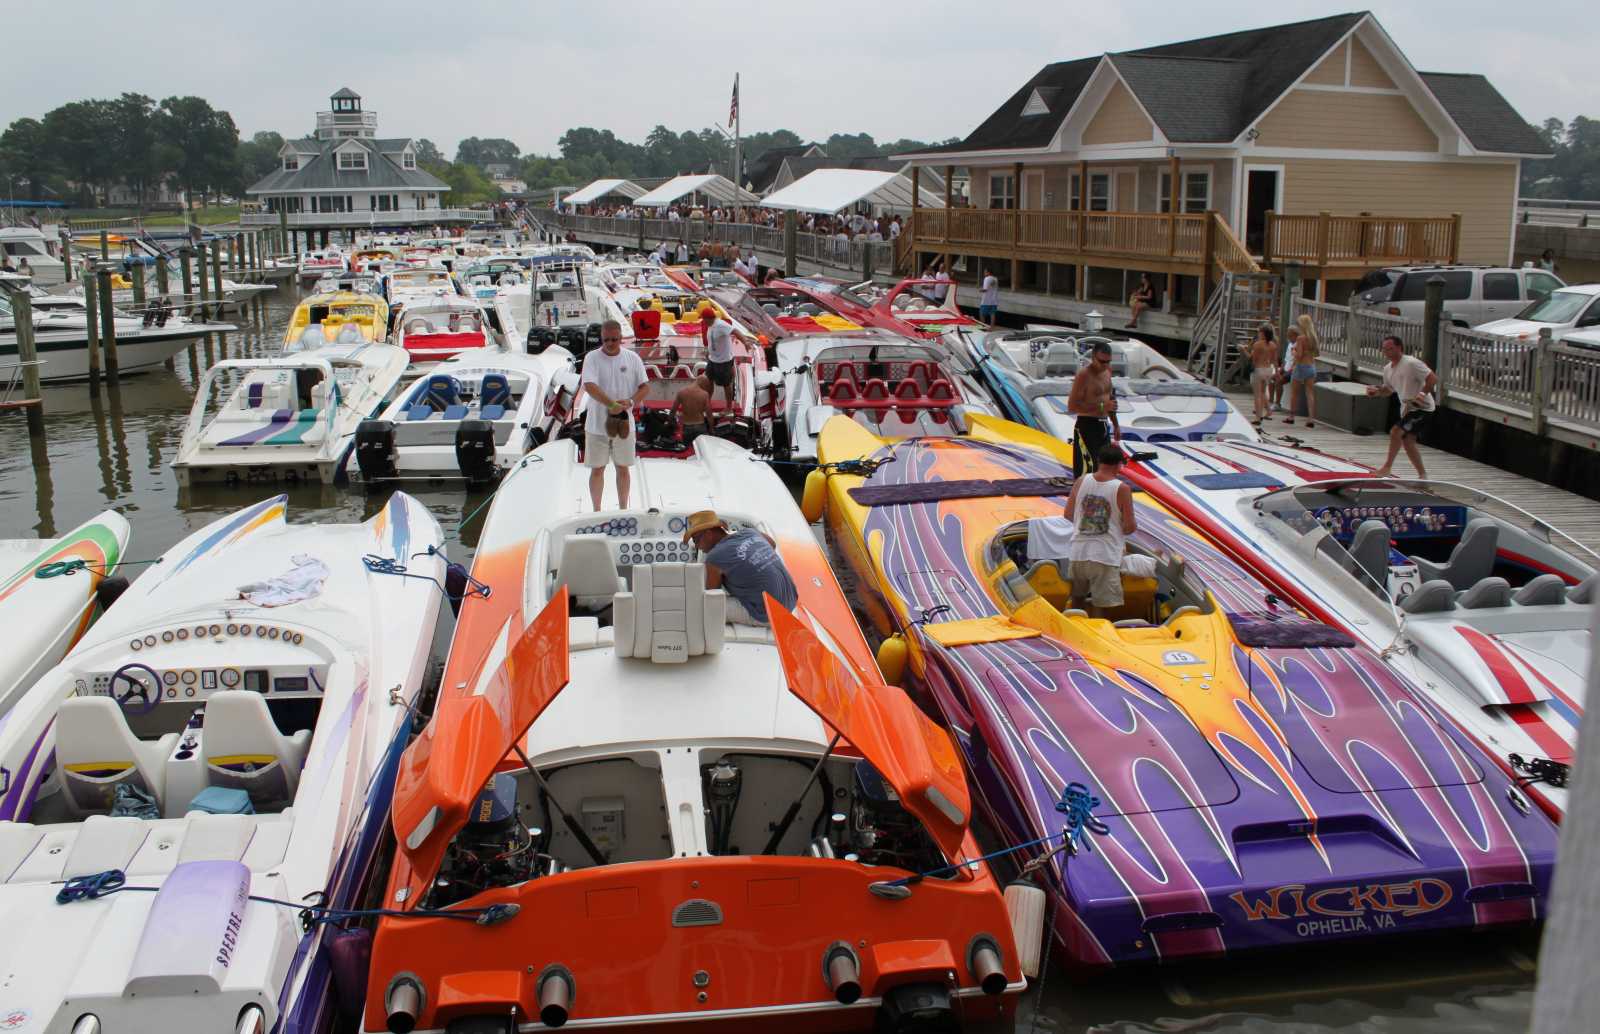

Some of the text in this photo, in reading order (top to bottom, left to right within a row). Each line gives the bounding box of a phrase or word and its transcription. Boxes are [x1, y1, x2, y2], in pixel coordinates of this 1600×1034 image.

[1229, 878, 1453, 920] WICKED
[216, 911, 242, 968] SPECTRE
[1297, 915, 1396, 937] OPHELIA, VA
